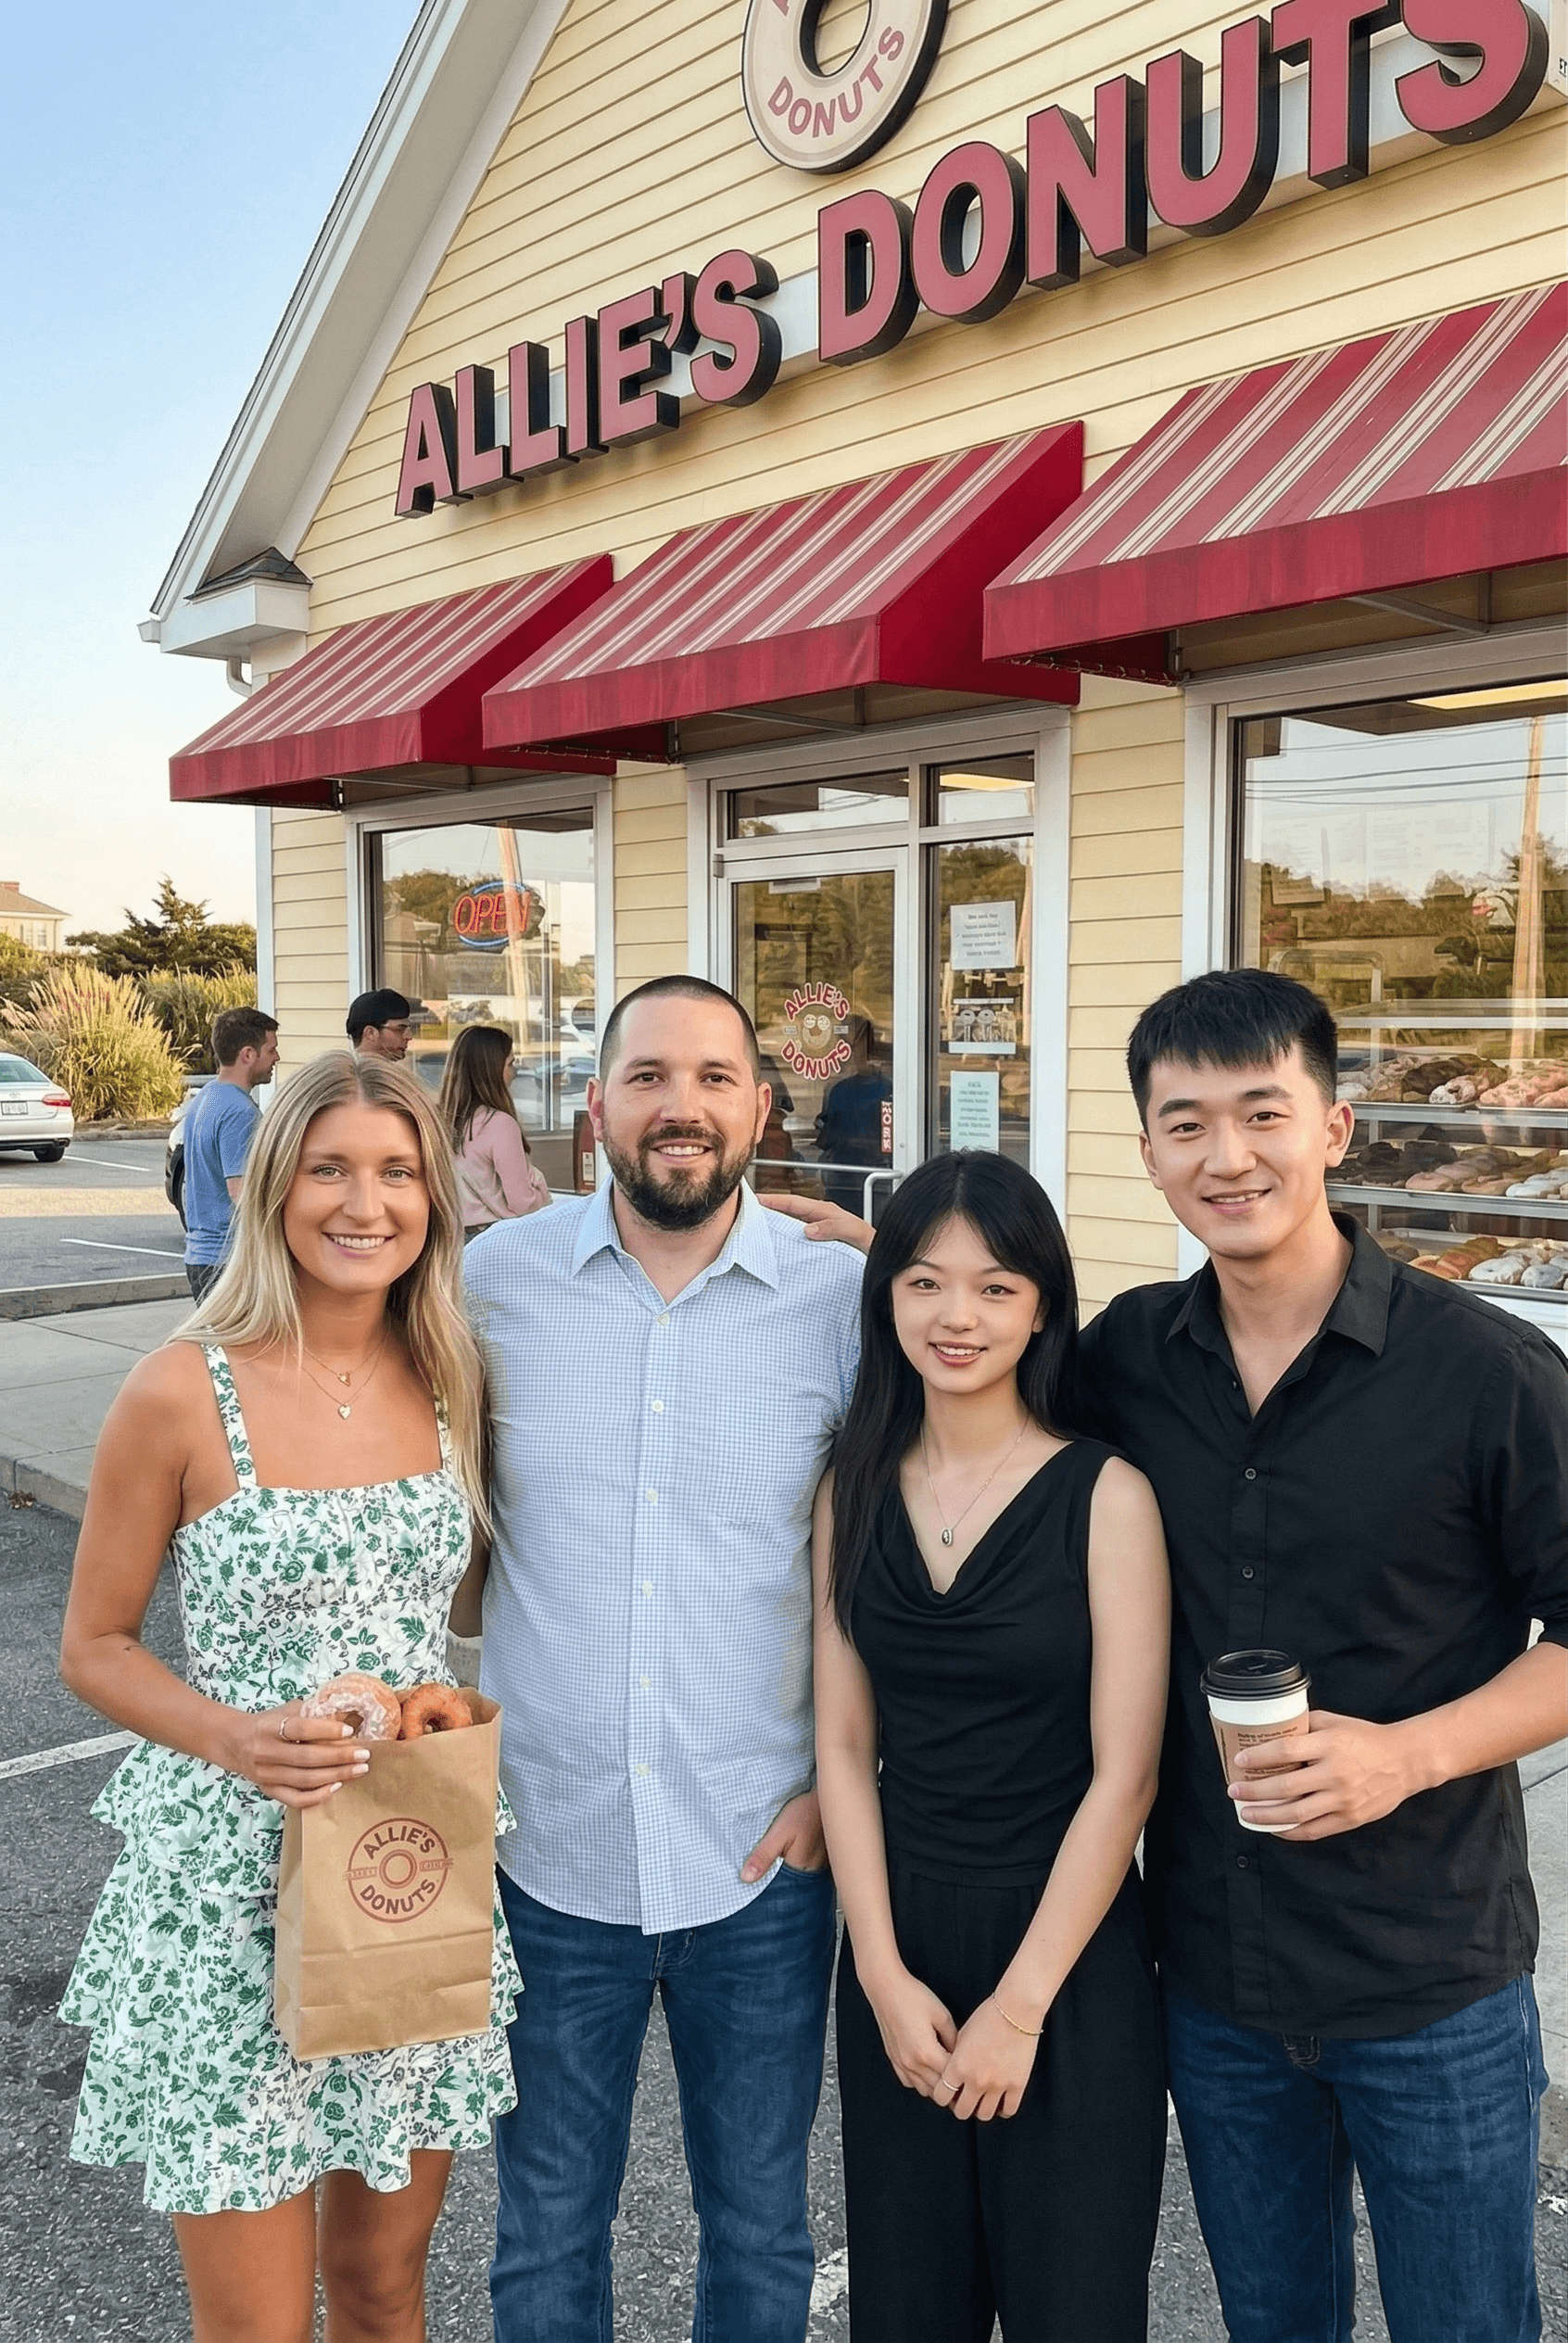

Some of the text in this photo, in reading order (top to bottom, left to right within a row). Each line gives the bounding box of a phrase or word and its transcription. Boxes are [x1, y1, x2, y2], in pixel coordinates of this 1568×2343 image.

[767, 26, 904, 138] DONUTS
[395, 0, 1548, 519] ALLIE'S DONUTS
[455, 891, 530, 934] OPEN
[785, 982, 850, 1021] ALLIE'S
[781, 1038, 851, 1080] DONUTS
[363, 1826, 436, 1859] ALLIE'S
[360, 1879, 436, 1915] DONUTS
